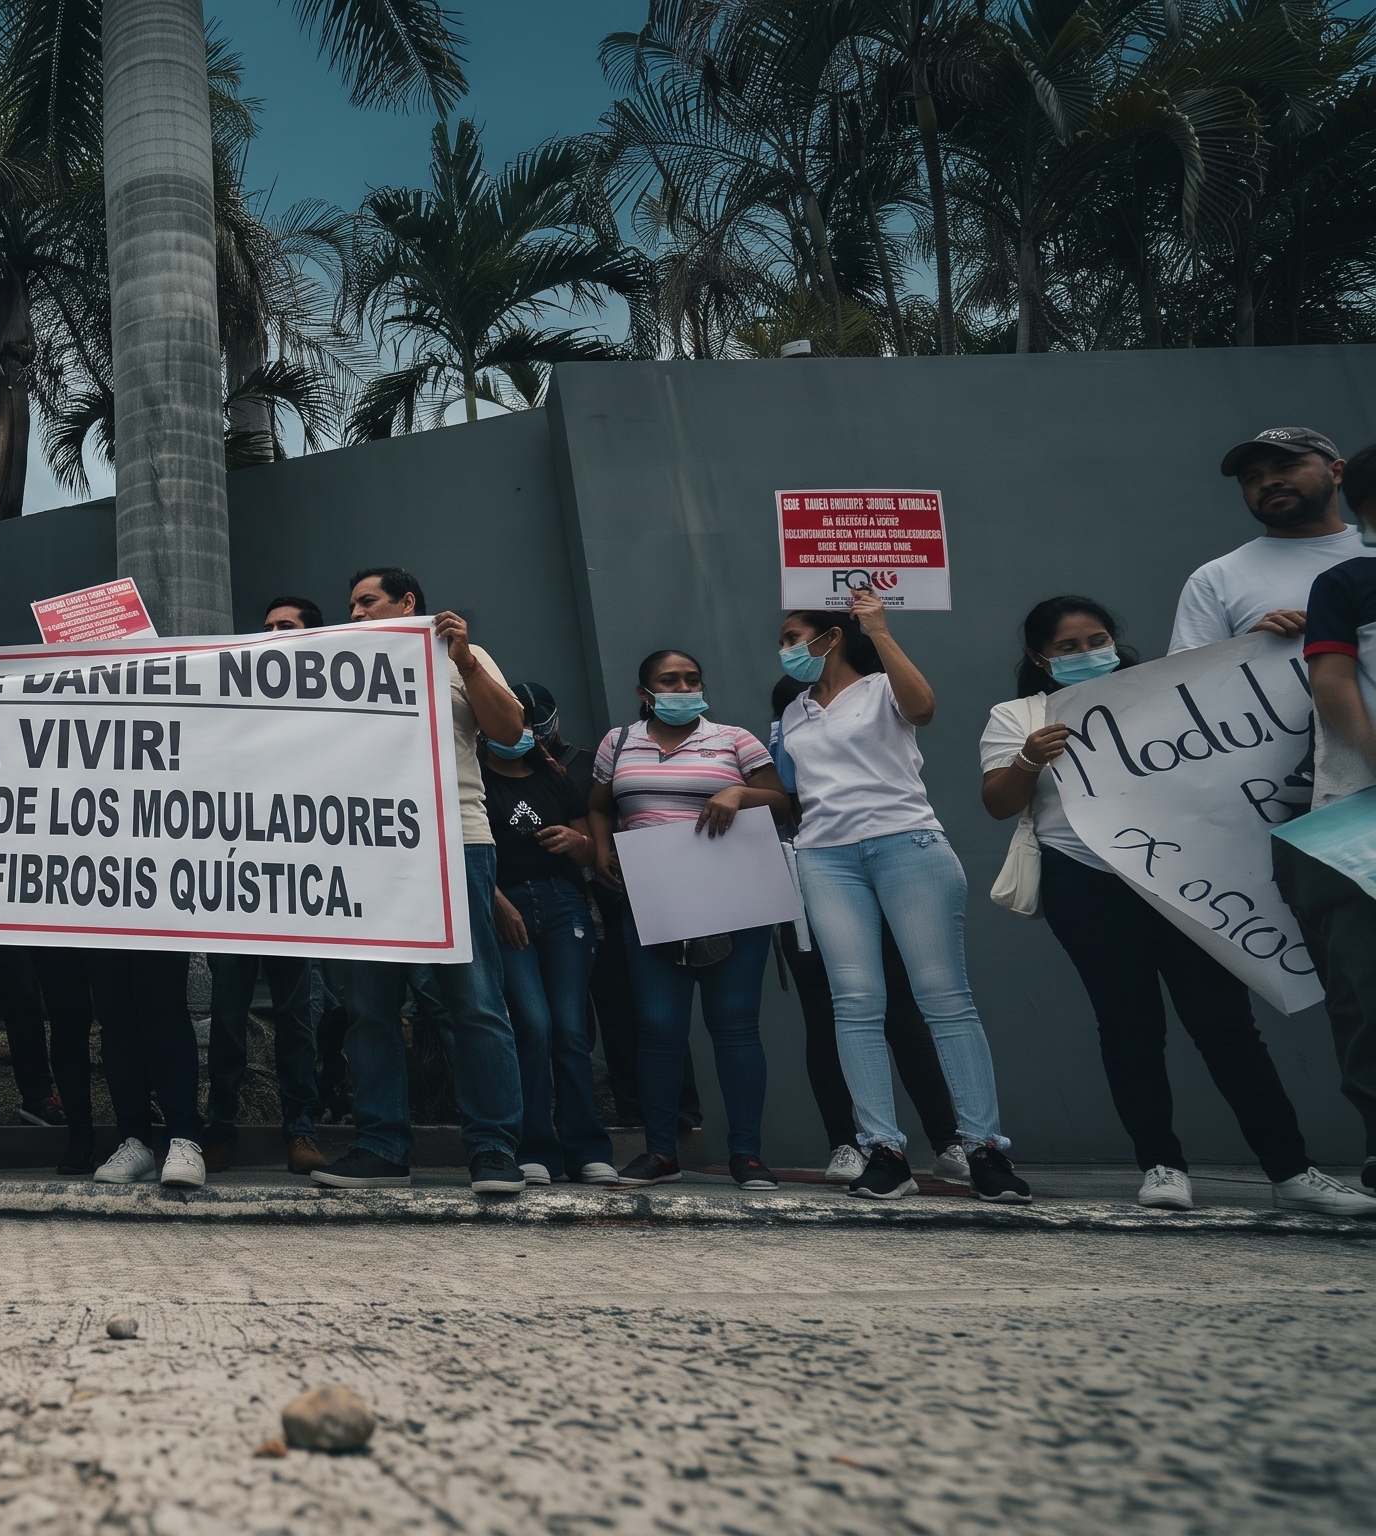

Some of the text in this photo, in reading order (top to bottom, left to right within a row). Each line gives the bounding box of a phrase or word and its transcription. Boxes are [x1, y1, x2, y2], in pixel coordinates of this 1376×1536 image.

[22, 655, 202, 696] DANIEL
[219, 650, 417, 706] NOBOA:
[18, 718, 181, 771] VIVIR!
[50, 787, 120, 838] LOS
[132, 789, 421, 850] MODULADORES
[169, 847, 363, 918] QUÍSTICA.
